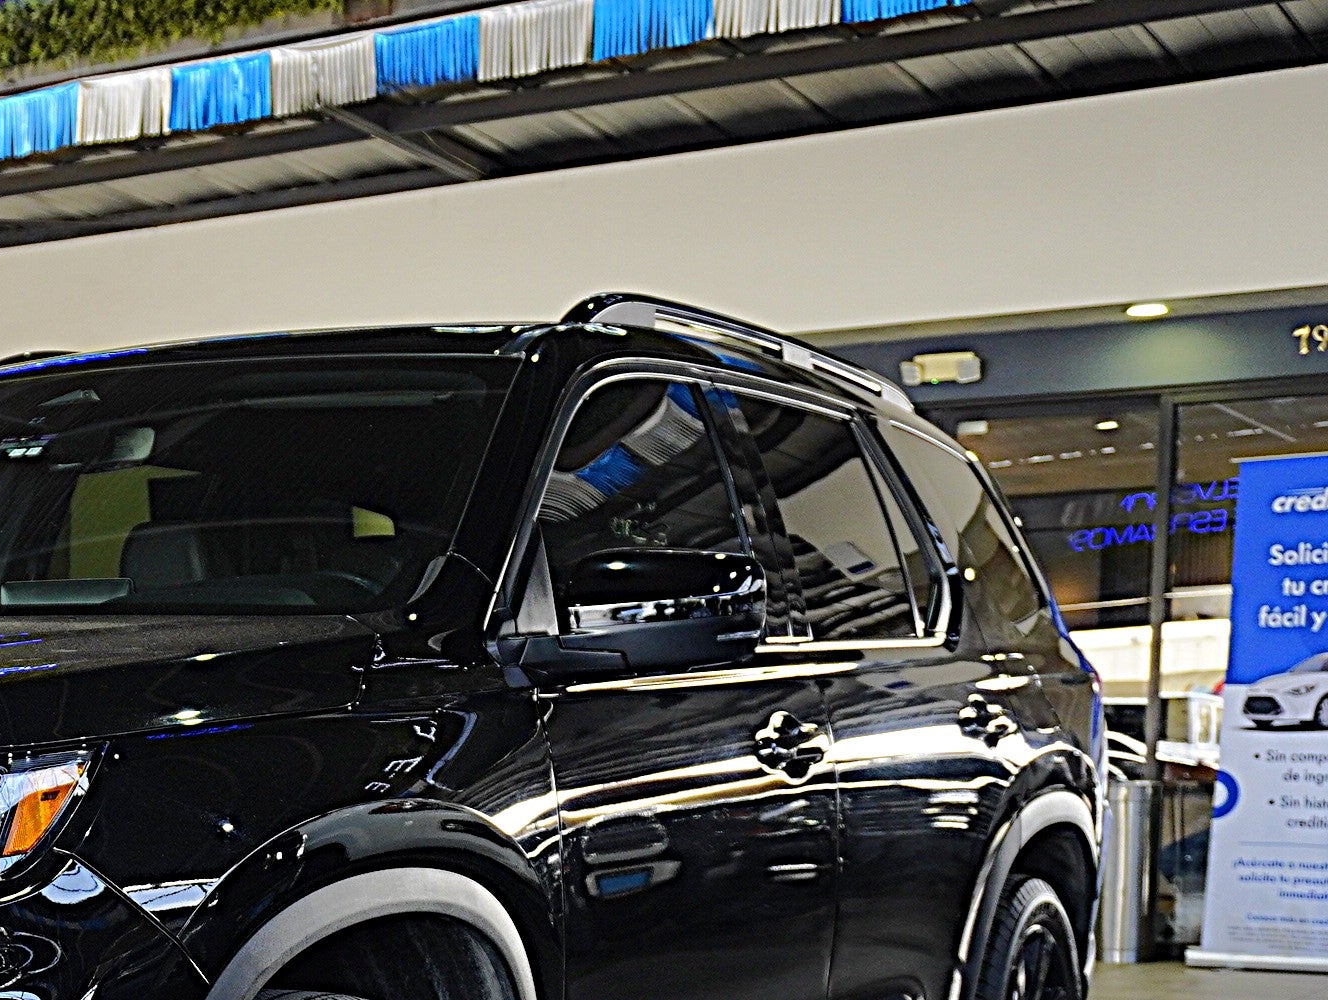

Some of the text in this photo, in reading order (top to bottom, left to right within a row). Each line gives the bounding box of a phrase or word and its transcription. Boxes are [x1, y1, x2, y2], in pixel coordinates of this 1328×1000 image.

[1282, 577, 1306, 597] tu
[1258, 604, 1328, 633] fácil y
[1266, 749, 1286, 761] Sin
[1283, 768, 1299, 781] de
[1280, 795, 1300, 808] Sin
